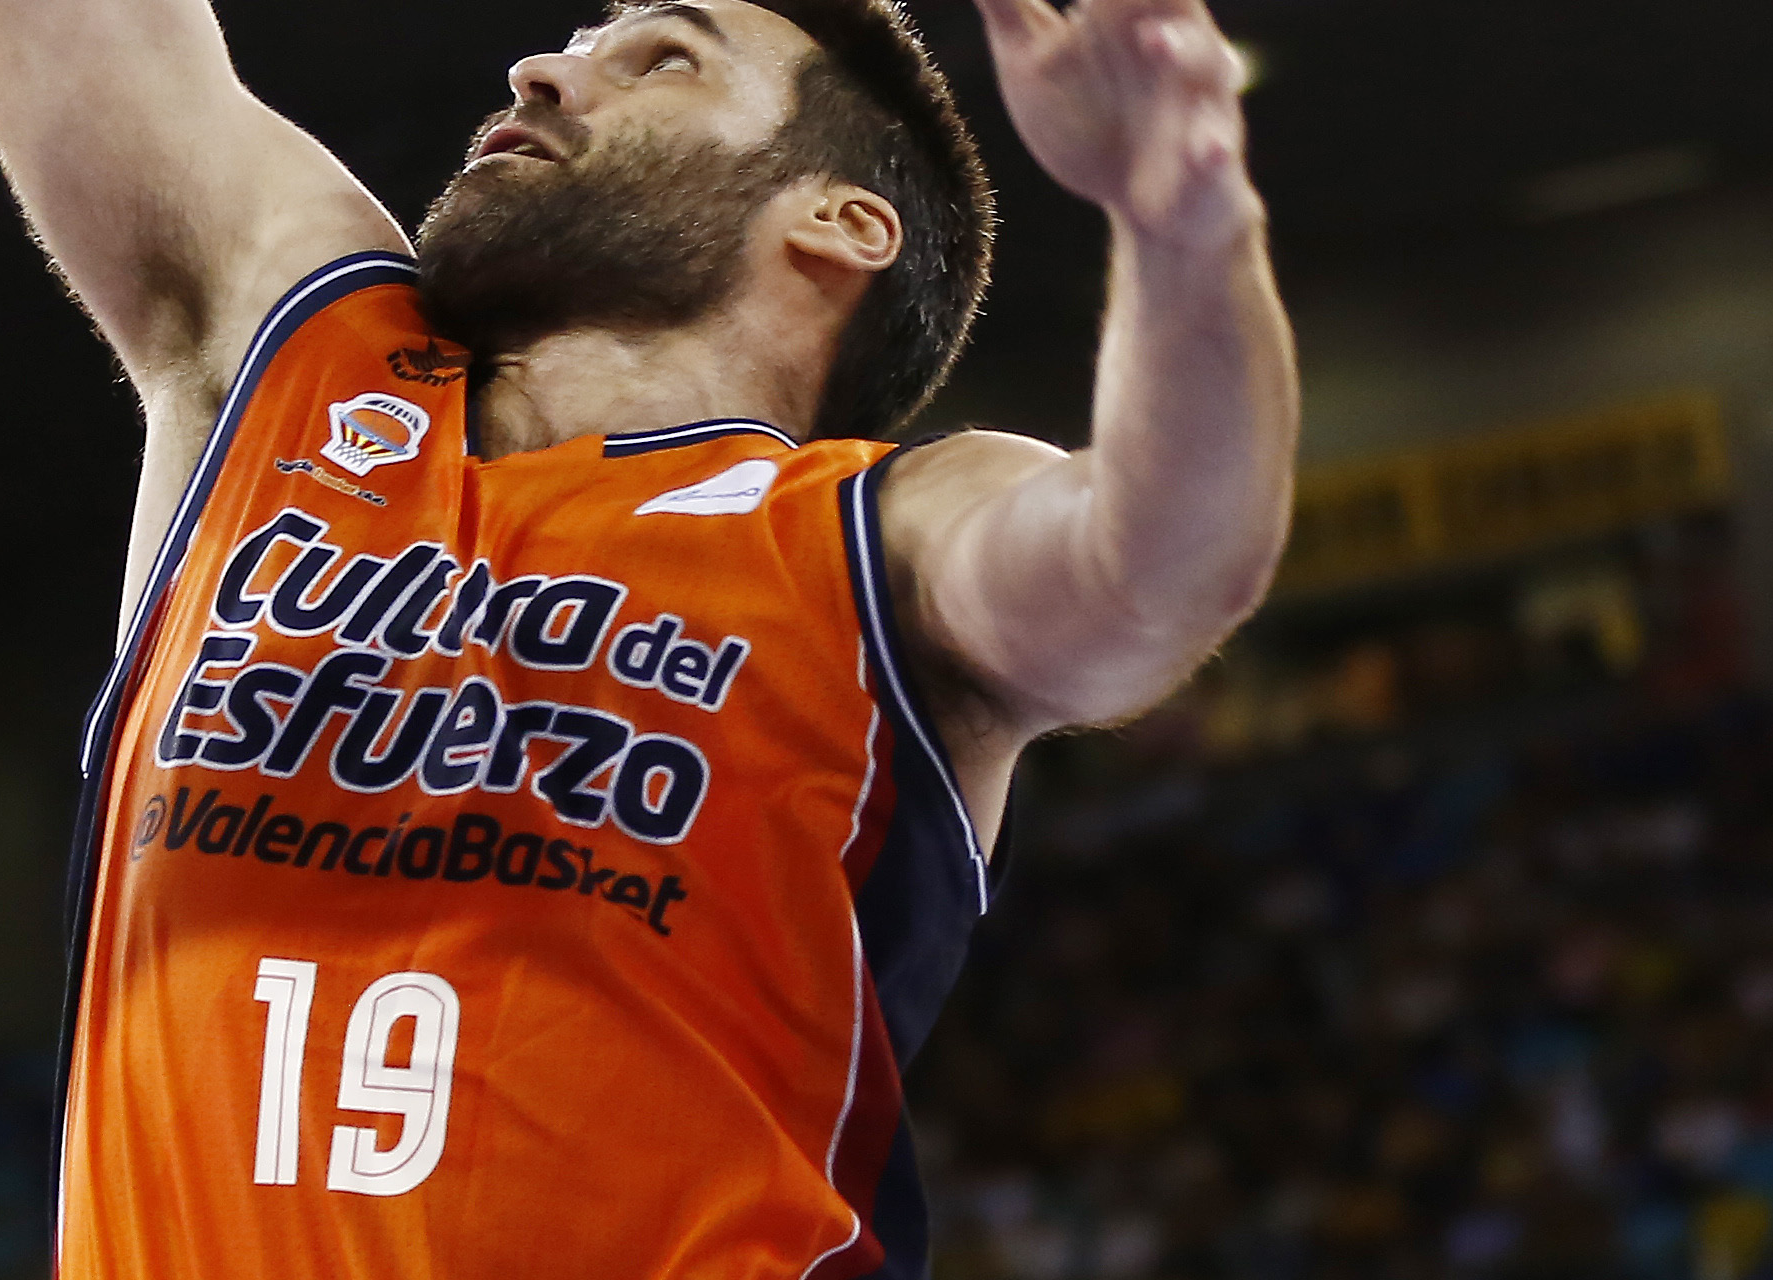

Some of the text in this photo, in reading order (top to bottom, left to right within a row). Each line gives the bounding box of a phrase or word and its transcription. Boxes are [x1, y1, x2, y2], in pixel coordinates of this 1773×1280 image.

[215, 507, 749, 712] Cultura del
[155, 630, 710, 846] Esfuerzo
[130, 786, 688, 937] @ValenciaBasket
[252, 956, 460, 1197] 19
